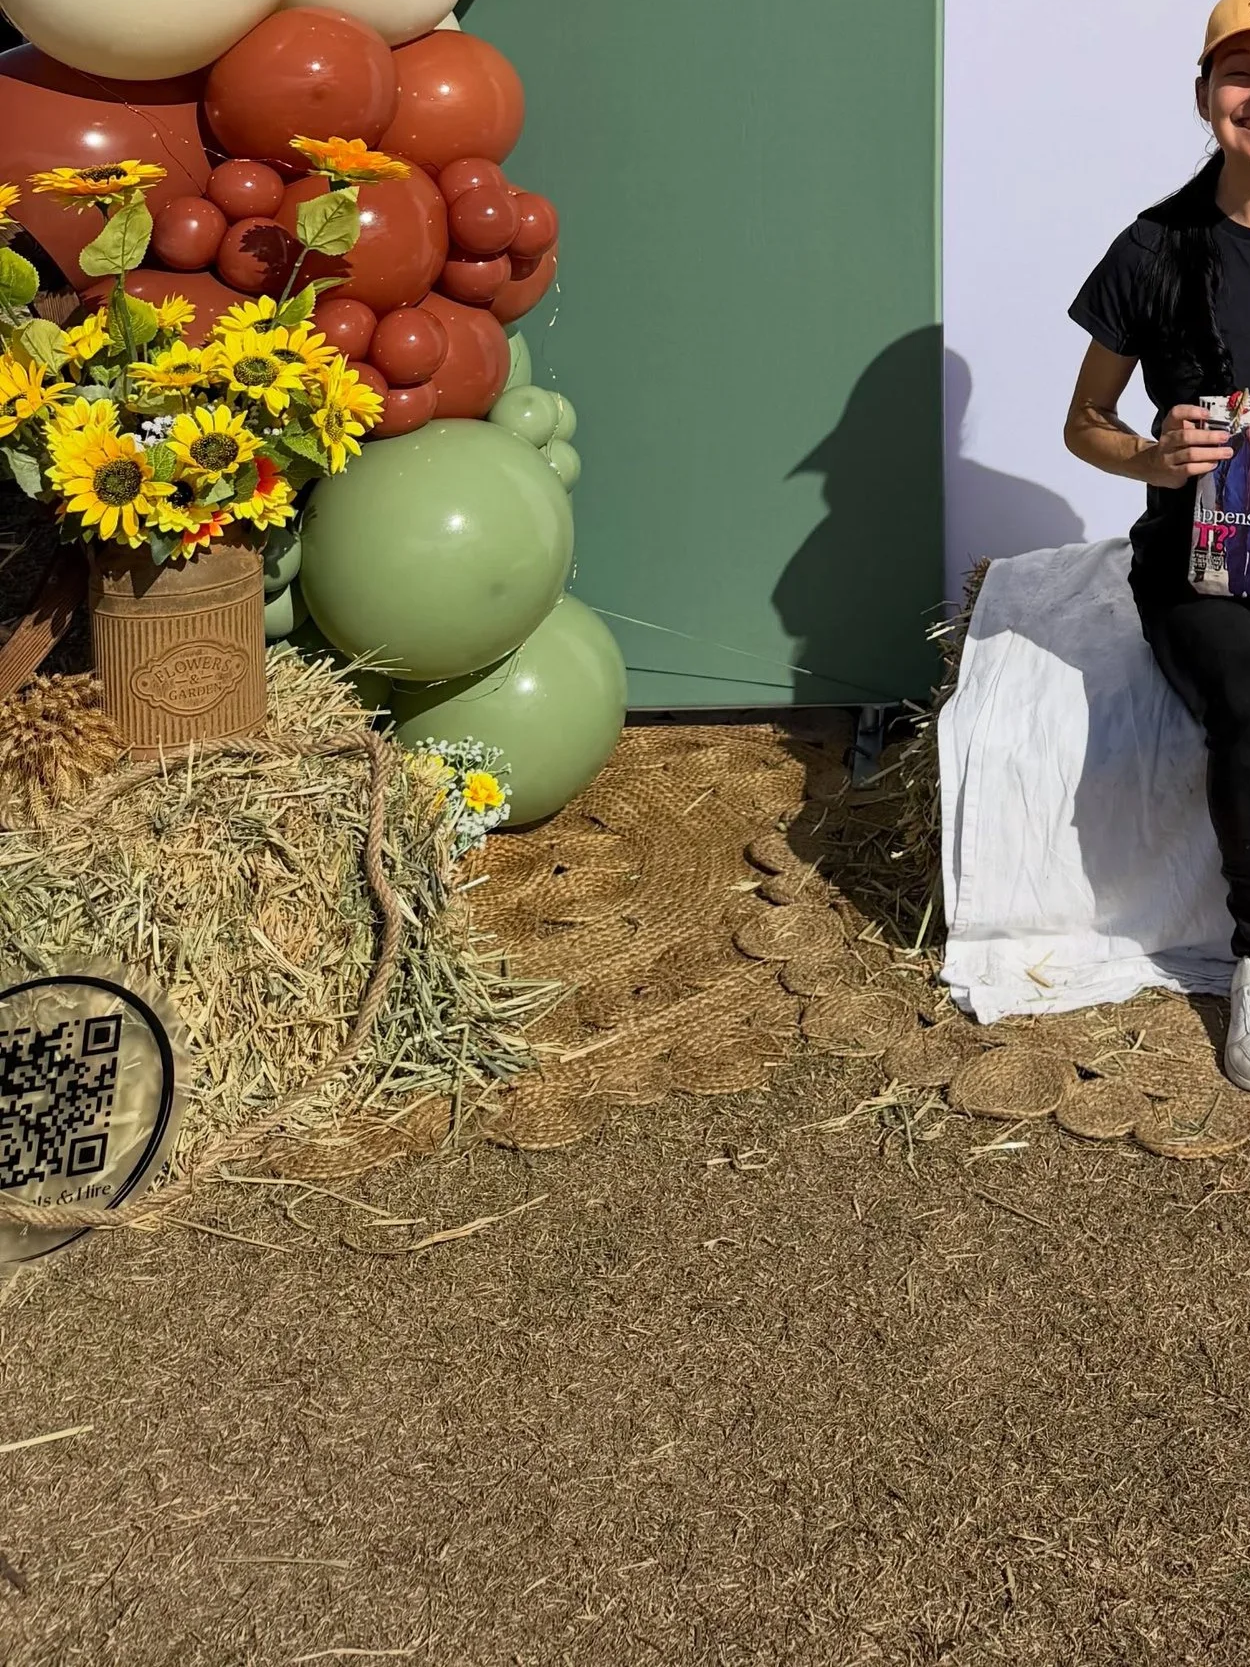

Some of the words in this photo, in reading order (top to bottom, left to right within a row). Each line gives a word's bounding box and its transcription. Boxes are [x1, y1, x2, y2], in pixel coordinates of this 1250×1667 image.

[154, 655, 232, 684] FLOWERS
[189, 673, 200, 685] &
[168, 681, 222, 701] GARDEN
[56, 1189, 73, 1206] &
[76, 1184, 112, 1202] Hire
